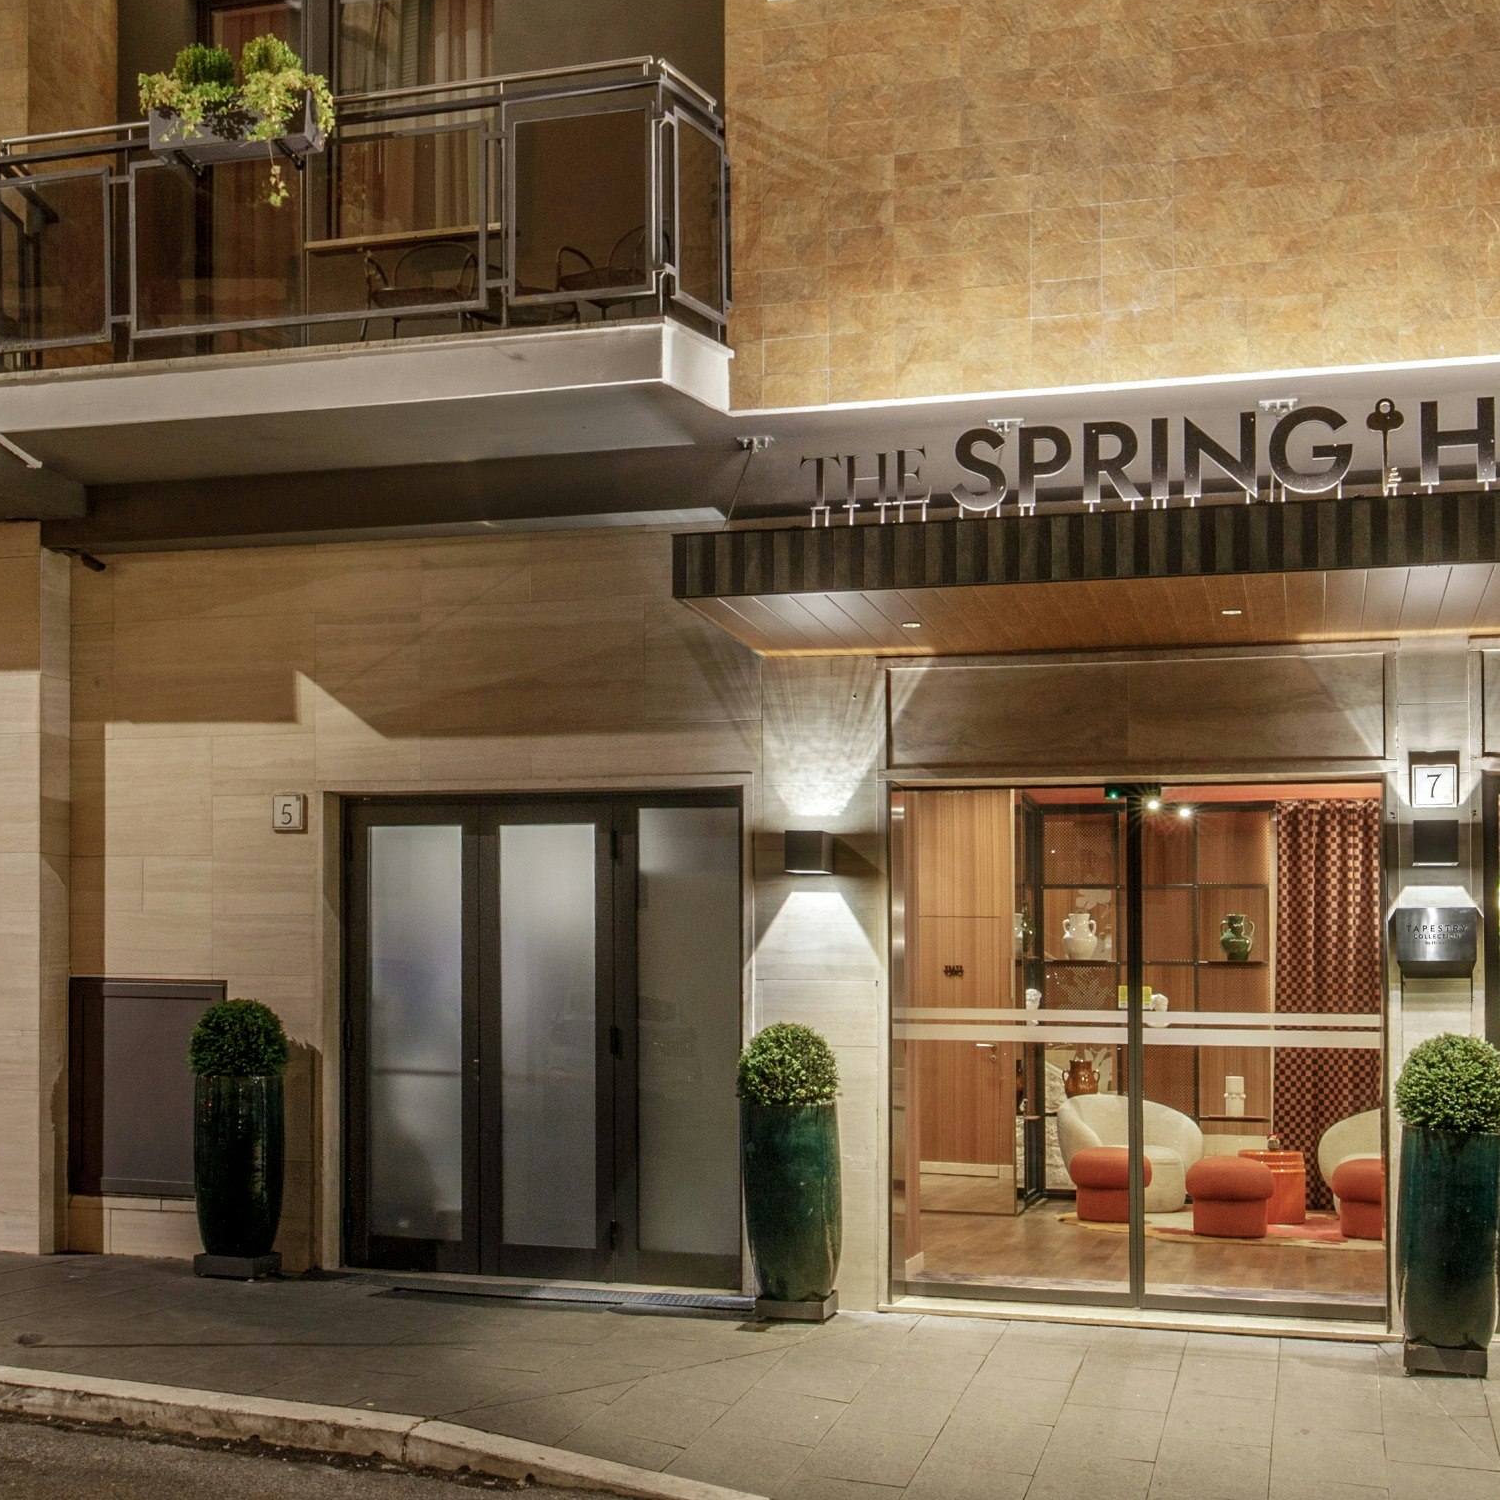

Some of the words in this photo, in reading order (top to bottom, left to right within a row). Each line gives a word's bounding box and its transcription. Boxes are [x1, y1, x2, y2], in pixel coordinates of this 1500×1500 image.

[800, 444, 931, 509] THE
[951, 406, 1353, 511] SPRING
[1426, 773, 1442, 799] 7
[281, 803, 293, 825] 5
[1406, 925, 1468, 933] TAPESTRY
